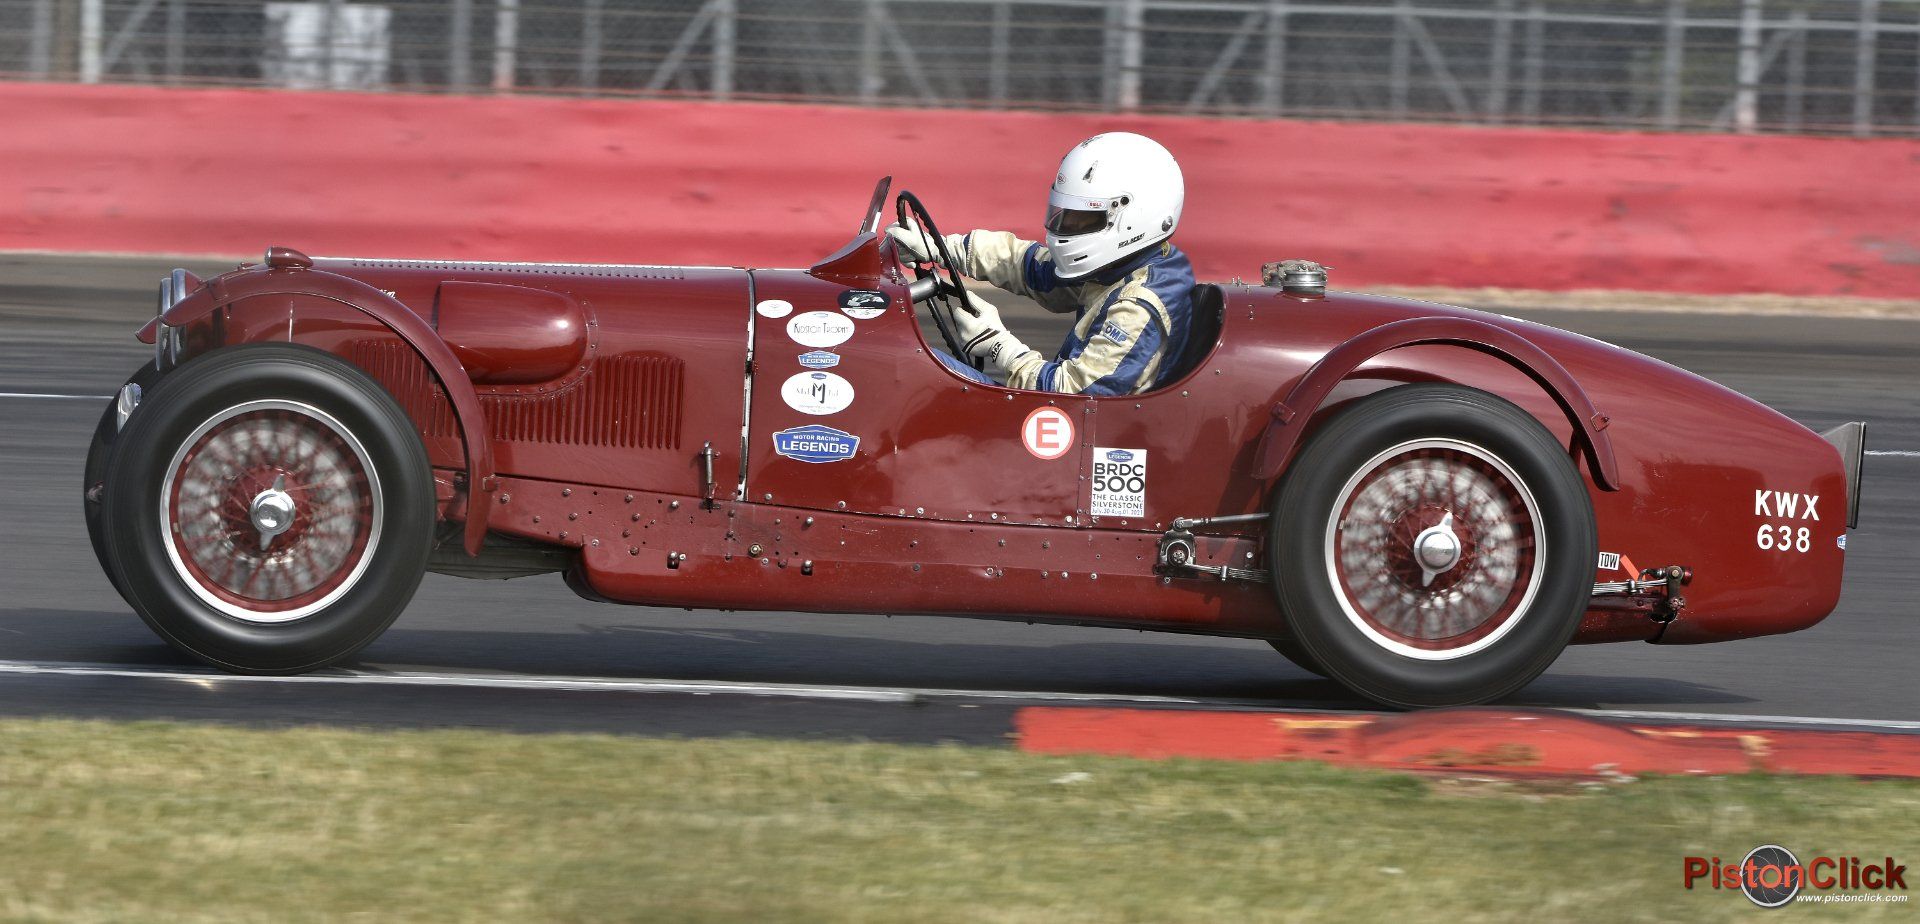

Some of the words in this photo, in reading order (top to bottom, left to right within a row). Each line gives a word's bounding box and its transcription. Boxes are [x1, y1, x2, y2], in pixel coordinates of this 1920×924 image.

[1105, 325, 1127, 342] OMP
[1036, 418, 1060, 449] E
[782, 441, 850, 454] LEGENDS
[1094, 462, 1144, 477] BRDC
[1093, 475, 1145, 494] 500
[1092, 500, 1143, 510] SILVERSTONE
[1755, 489, 1820, 521] KWX
[1757, 524, 1811, 553] 638
[1600, 553, 1618, 569] TOW
